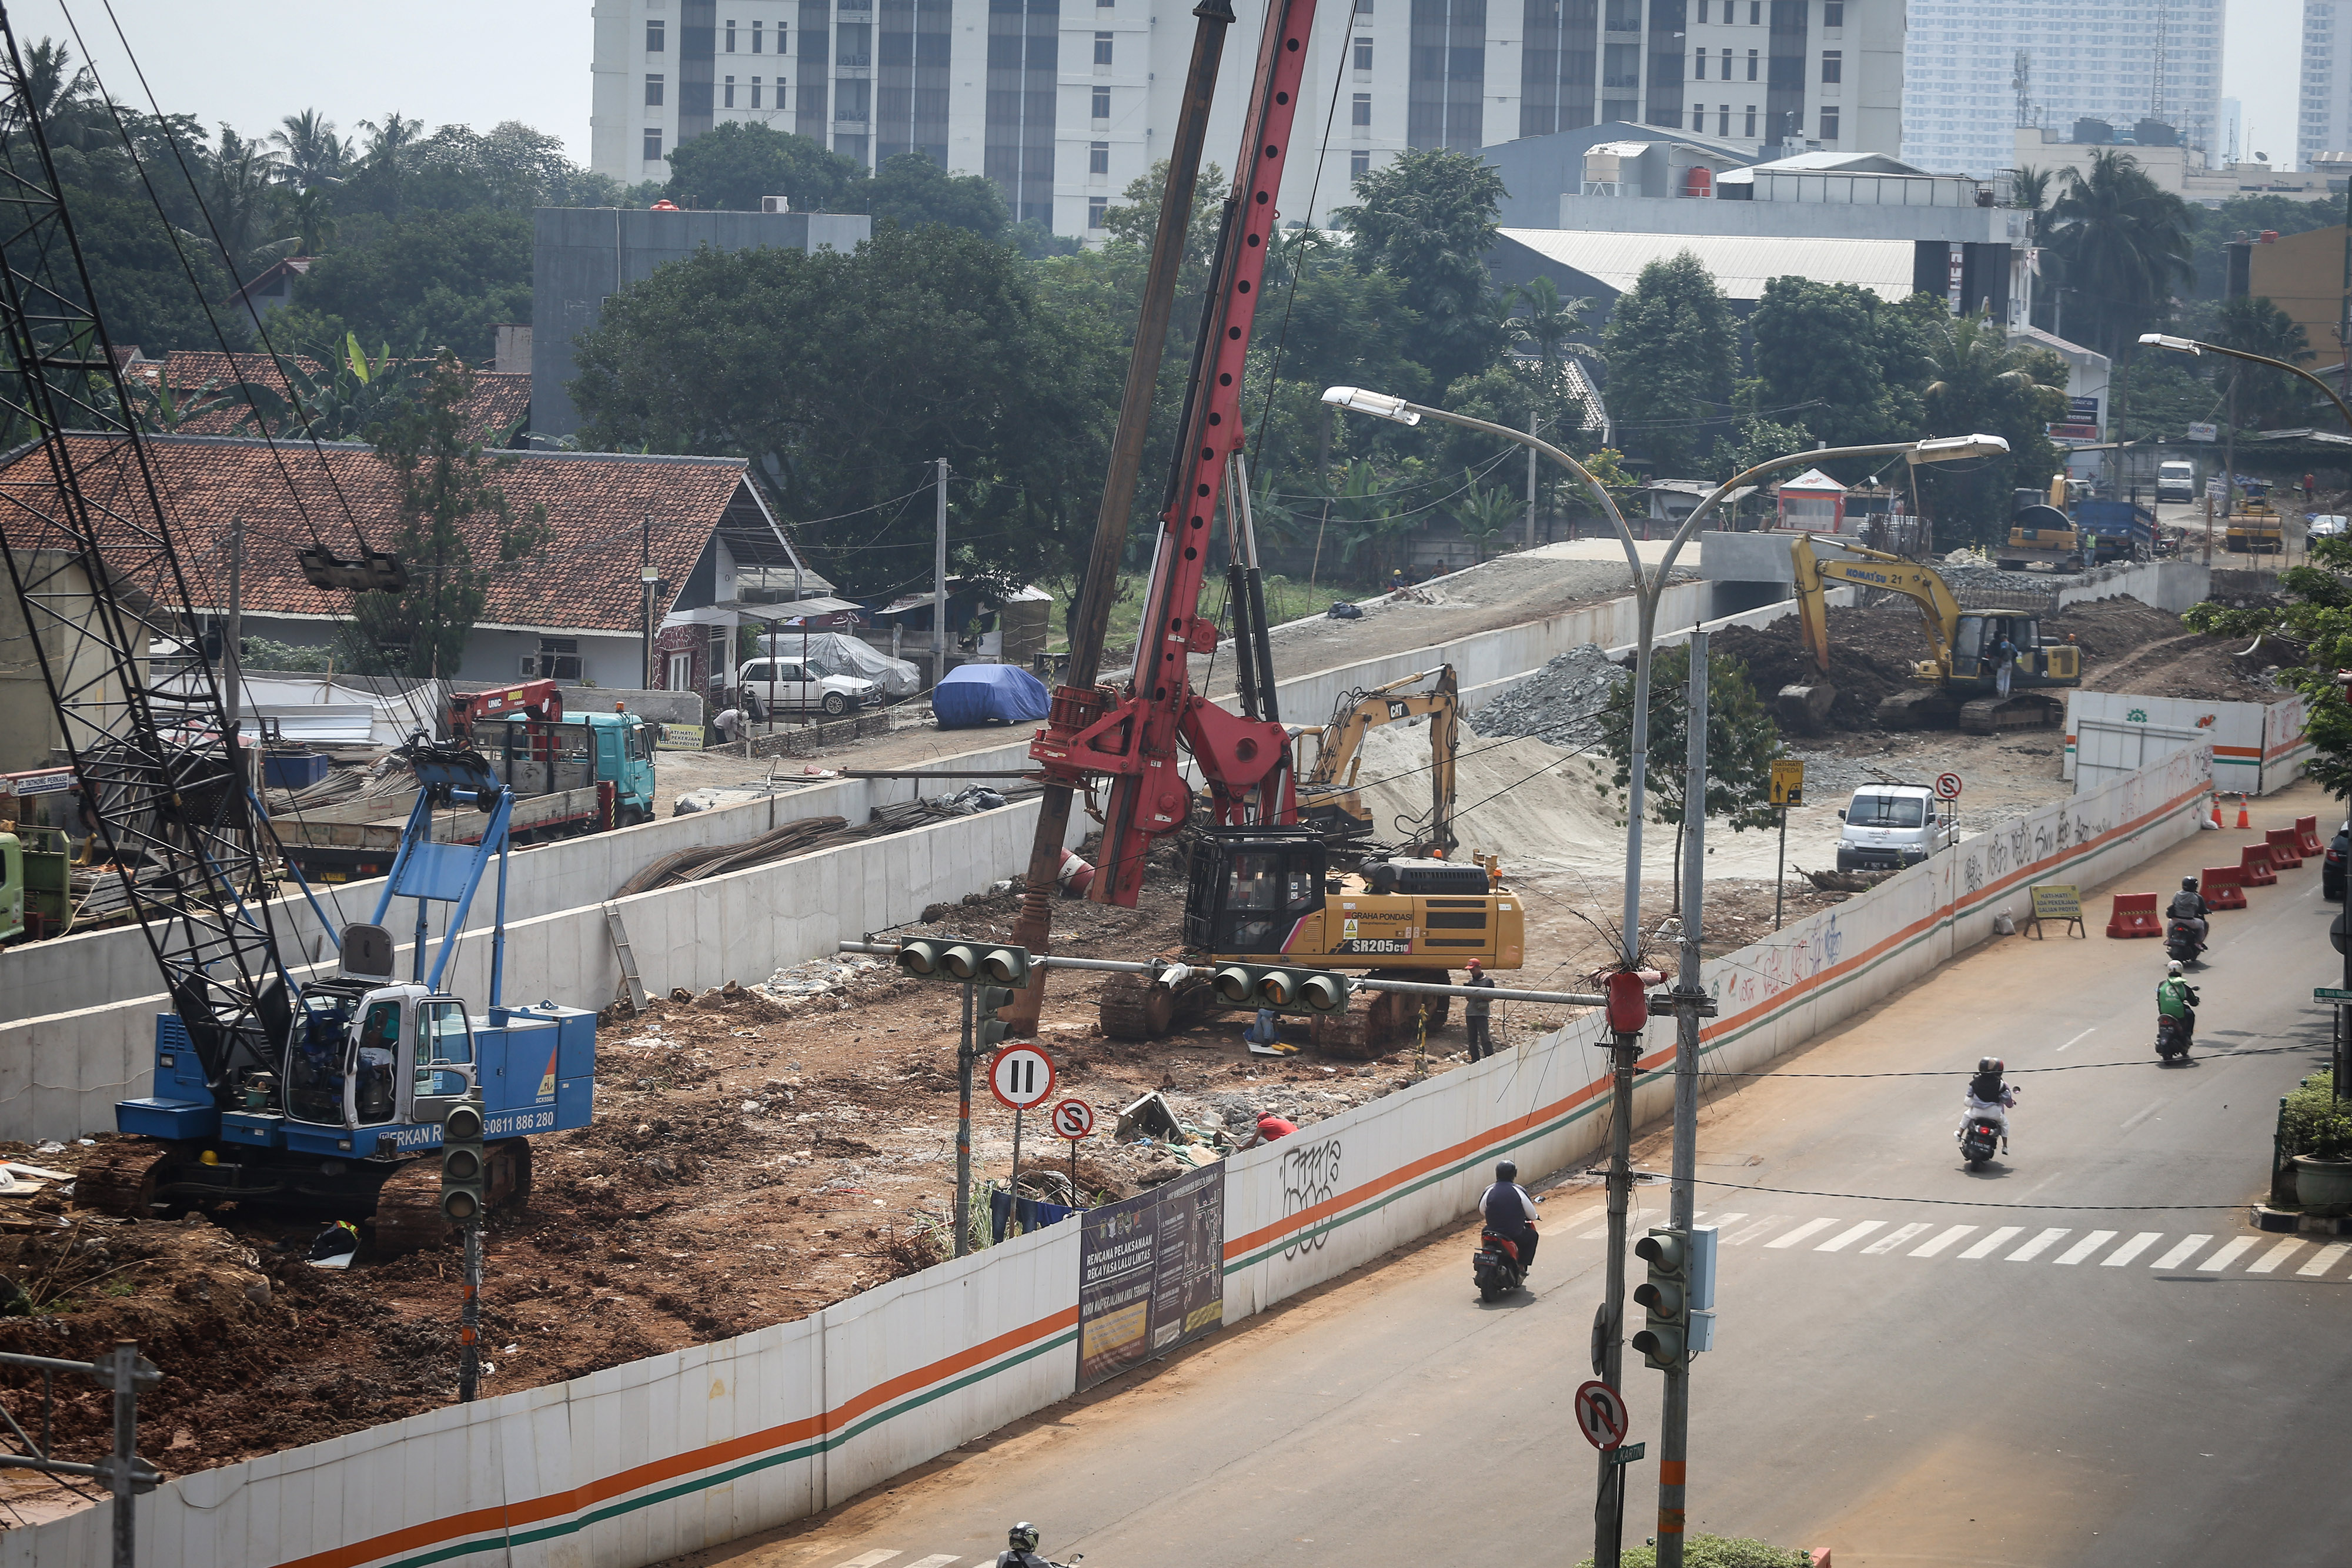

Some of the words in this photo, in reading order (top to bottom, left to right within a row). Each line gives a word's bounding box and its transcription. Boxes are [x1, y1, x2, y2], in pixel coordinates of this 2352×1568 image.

[1846, 568, 1886, 583] KOMATSU
[1891, 574, 1902, 584] 21
[488, 698, 502, 708] UNIC
[1391, 703, 1403, 717] CAT
[48, 775, 68, 784] PERKASA
[490, 1116, 513, 1134] 0811
[516, 1114, 533, 1131] 886
[536, 1111, 553, 1128] 280
[1087, 1248, 1114, 1266] RENCANA
[1114, 1234, 1152, 1258] PELAKSANAAN
[1087, 1261, 1117, 1281] REKAYASA
[1118, 1255, 1132, 1270] LALU
[1132, 1249, 1151, 1265] LINTAS
[1619, 1445, 1644, 1462] KARTINI
